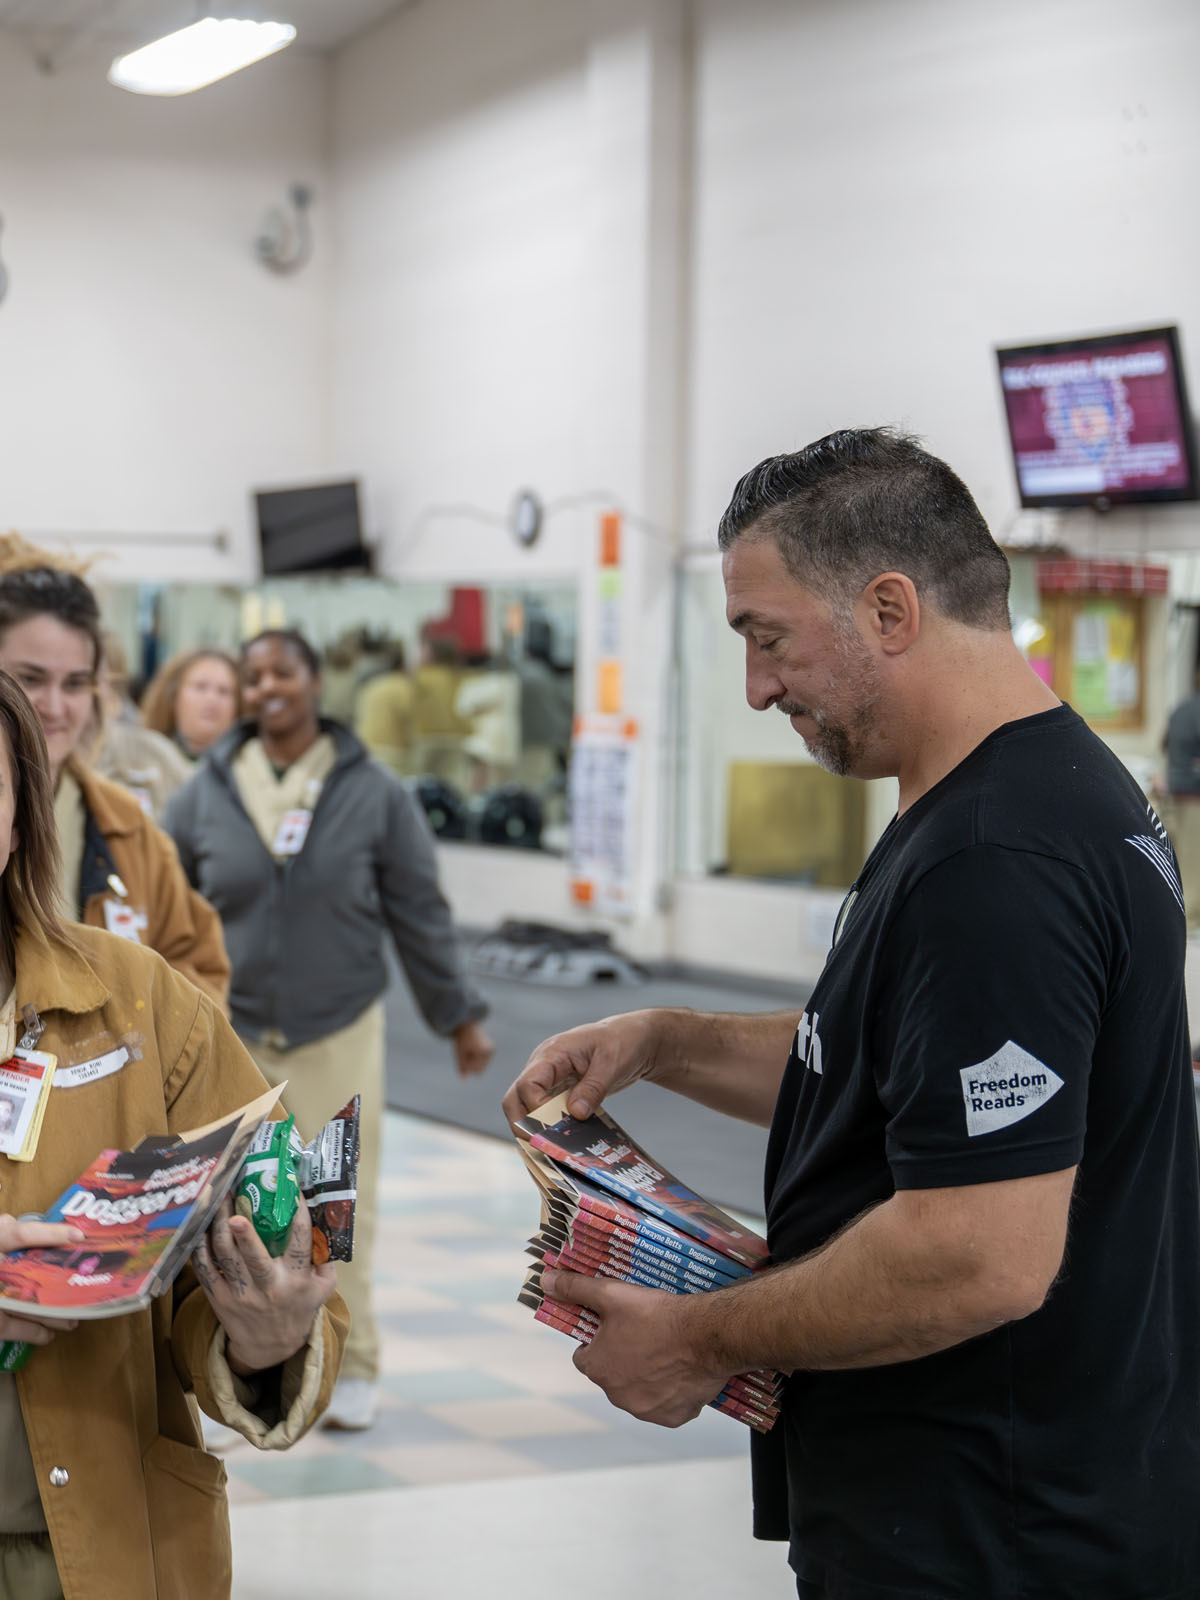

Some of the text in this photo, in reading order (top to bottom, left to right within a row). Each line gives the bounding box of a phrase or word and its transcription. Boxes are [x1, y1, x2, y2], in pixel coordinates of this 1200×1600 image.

[969, 1072, 1048, 1095] Freedom
[972, 1092, 1025, 1112] Reads
[614, 1228, 716, 1279] Reginald Dwayne Betts Doggerel
[615, 1214, 641, 1231] Reginald
[640, 1223, 665, 1242] Dwayne
[665, 1235, 682, 1250] Betts
[688, 1247, 716, 1265] Doggerel
[600, 1263, 626, 1280] Reginald
[609, 1237, 712, 1288] Reginald Dwayne Betts Doggerel
[609, 1247, 635, 1263] Reginald
[635, 1257, 660, 1275] Dwayne
[660, 1269, 677, 1284] Betts
[609, 1258, 678, 1295] Reginald Dwayne Betts
[744, 1387, 762, 1398] NORTON
[745, 1410, 763, 1422] NORTON
